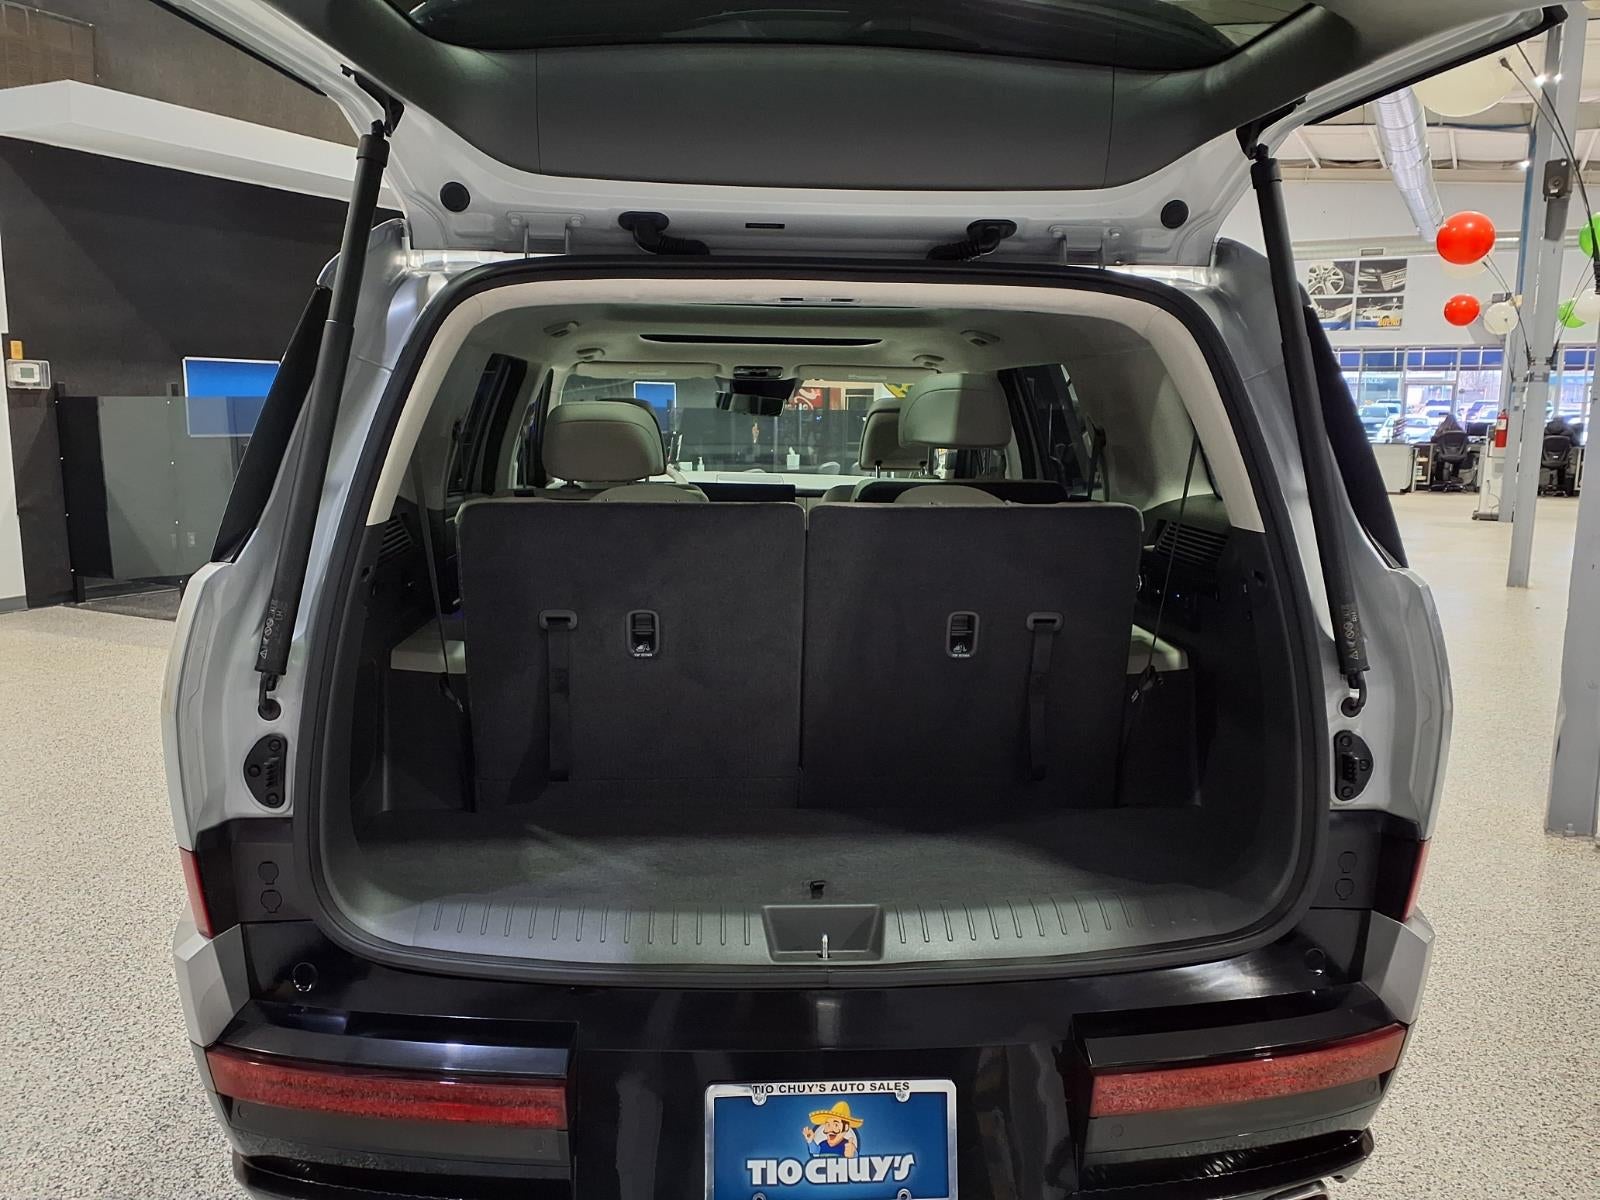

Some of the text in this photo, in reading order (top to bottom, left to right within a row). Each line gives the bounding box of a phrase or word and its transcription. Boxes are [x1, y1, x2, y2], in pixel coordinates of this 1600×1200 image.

[752, 1081, 910, 1095] TIO CHUY'S AUTO SALES
[747, 1154, 915, 1185] TIO CHUY'S
